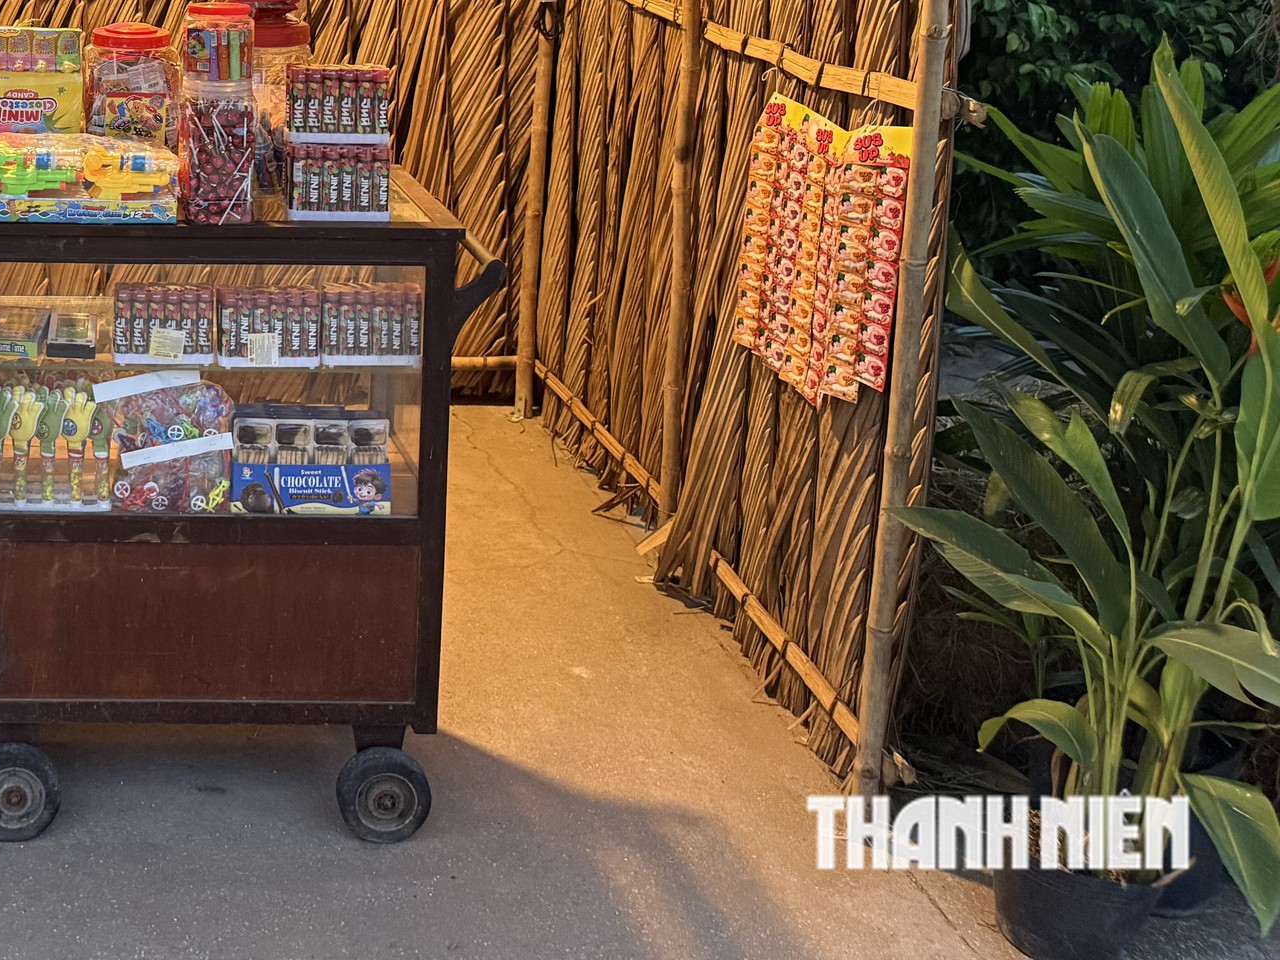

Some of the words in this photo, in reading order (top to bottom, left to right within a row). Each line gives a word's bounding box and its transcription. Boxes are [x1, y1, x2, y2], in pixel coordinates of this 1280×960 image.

[310, 174, 318, 202] JINJIN
[330, 175, 338, 203] JINJIN
[343, 172, 351, 201] JINJIN
[380, 177, 388, 205] JINJIN
[360, 319, 368, 347] JINJIN
[392, 321, 400, 349] JINJIN
[410, 318, 418, 347] JINJIN
[11, 343, 25, 353] Time
[281, 476, 341, 488] CHOCOLATE
